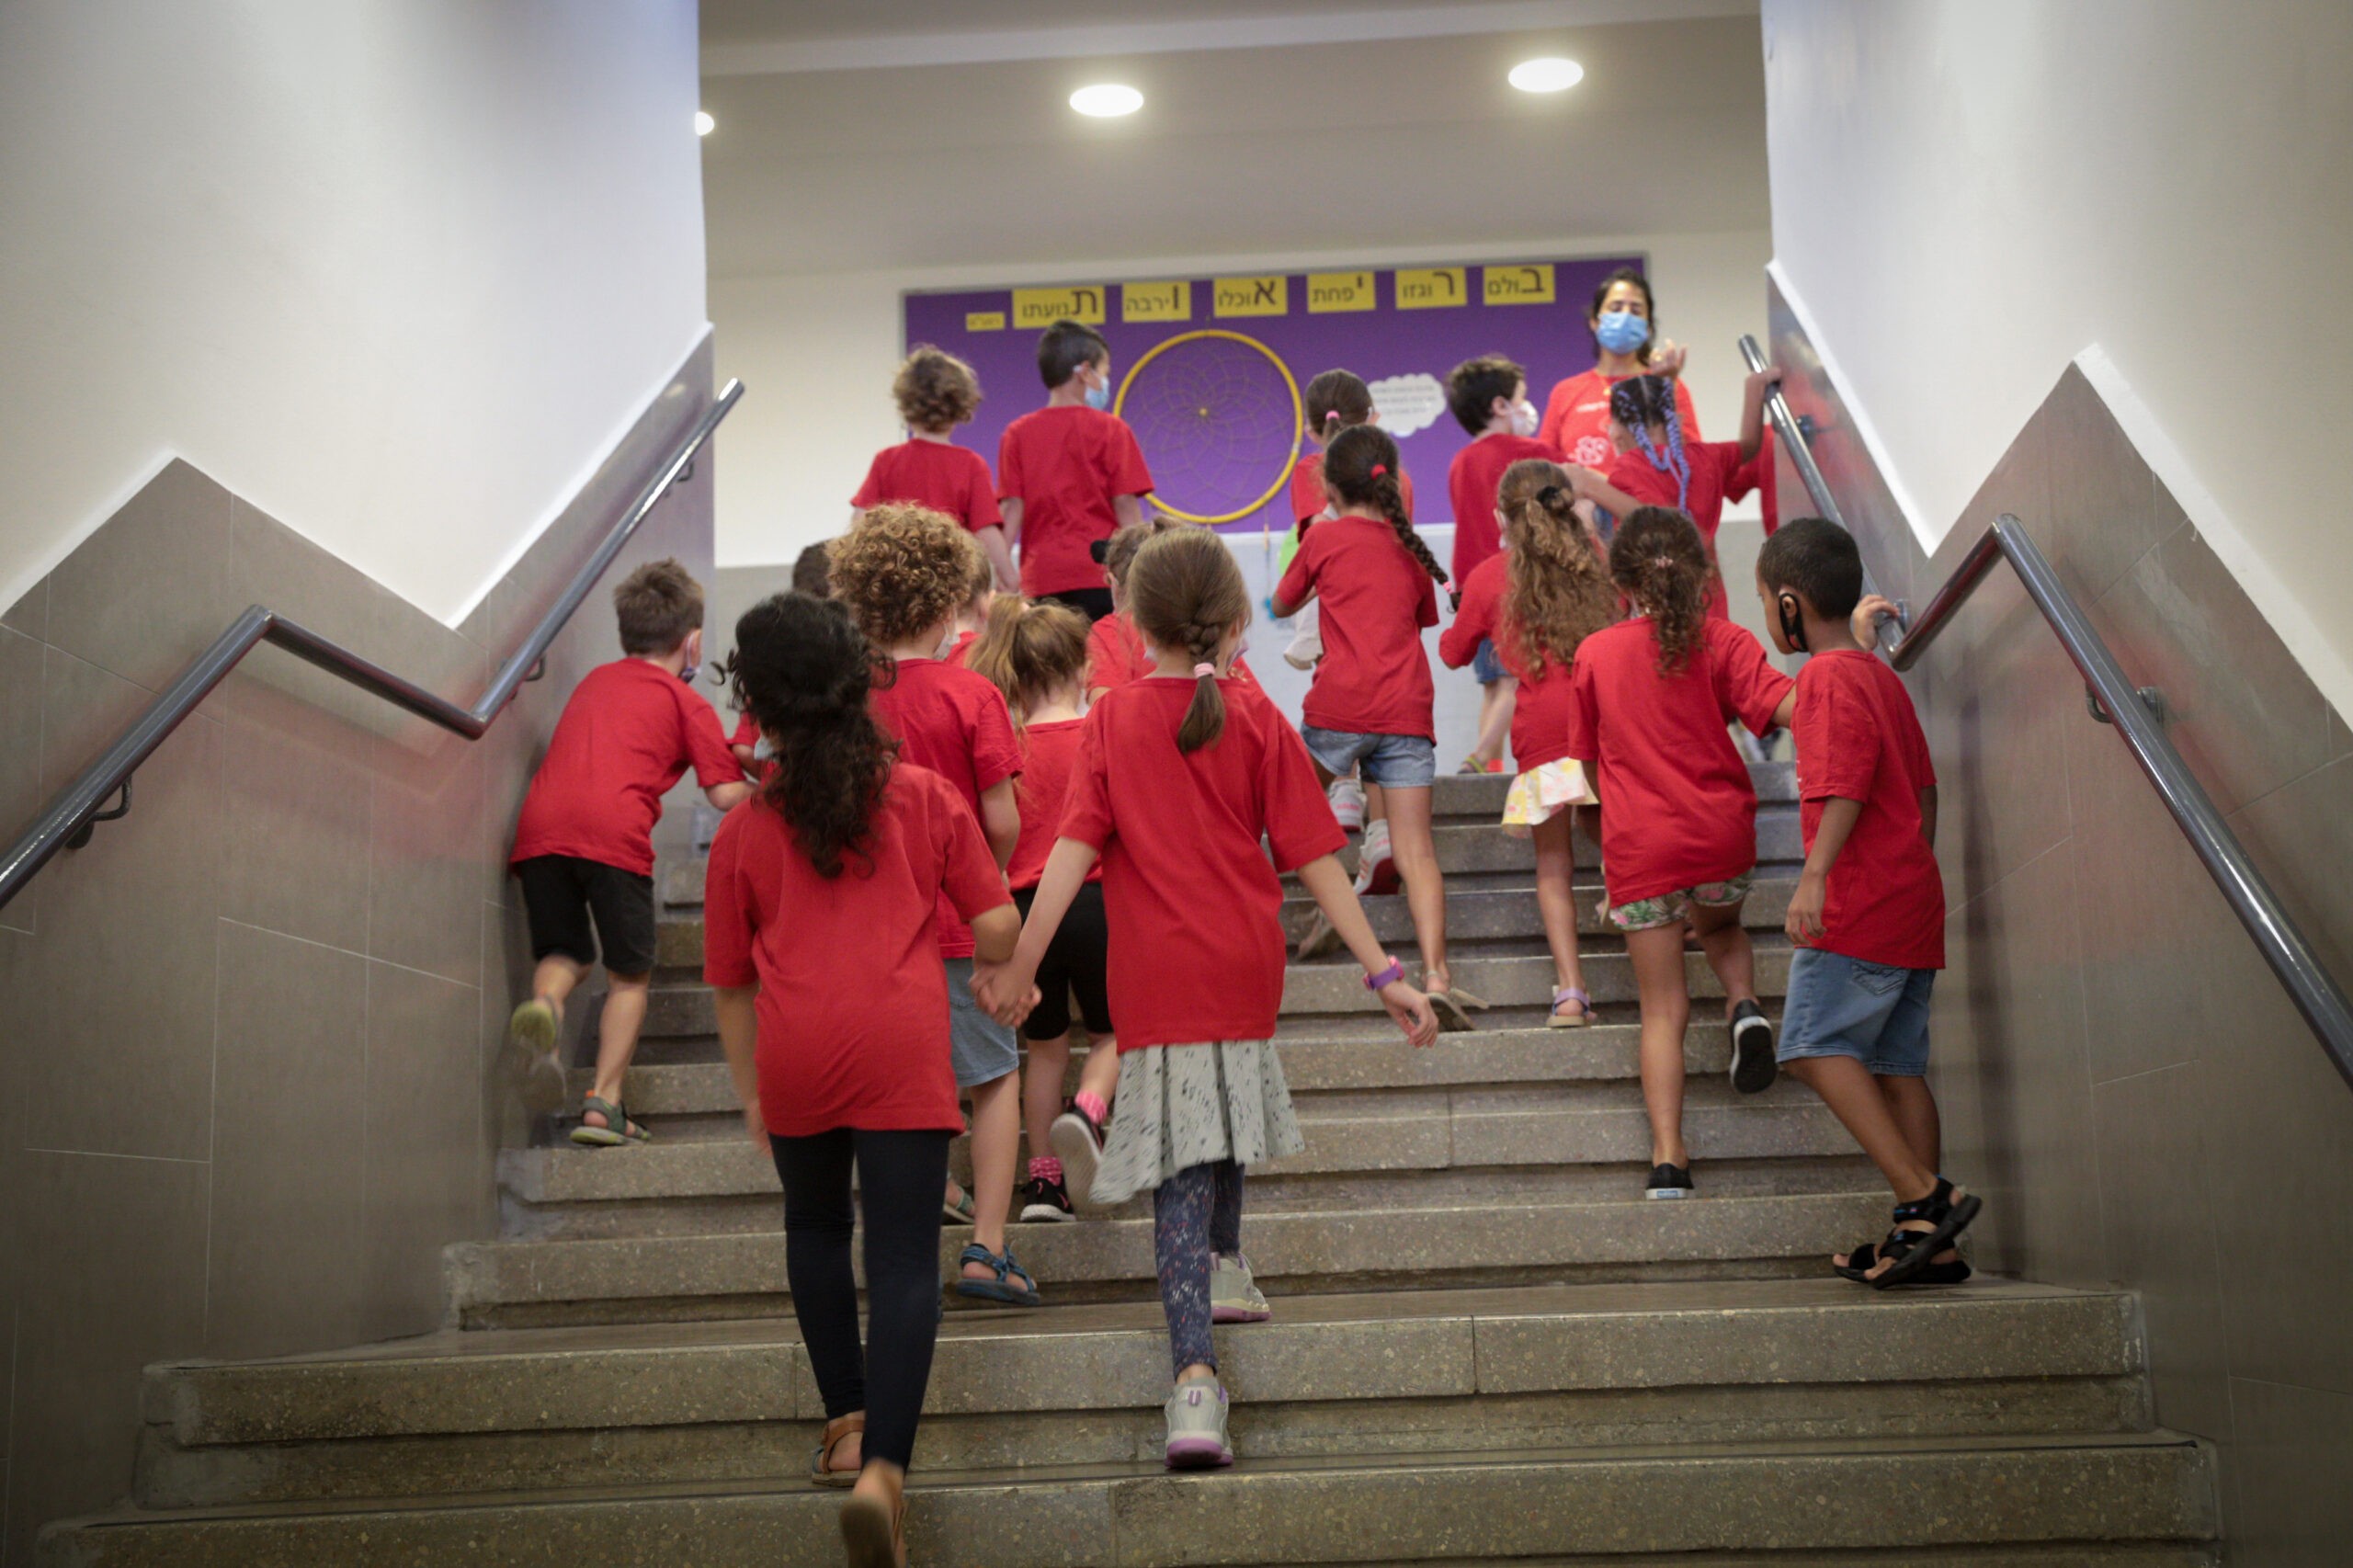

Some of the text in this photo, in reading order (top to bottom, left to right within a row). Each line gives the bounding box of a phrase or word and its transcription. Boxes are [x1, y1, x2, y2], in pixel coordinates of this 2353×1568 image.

[1022, 267, 1545, 318] בולם רוגזו יפחת אוכלו וירבה תנועתו
